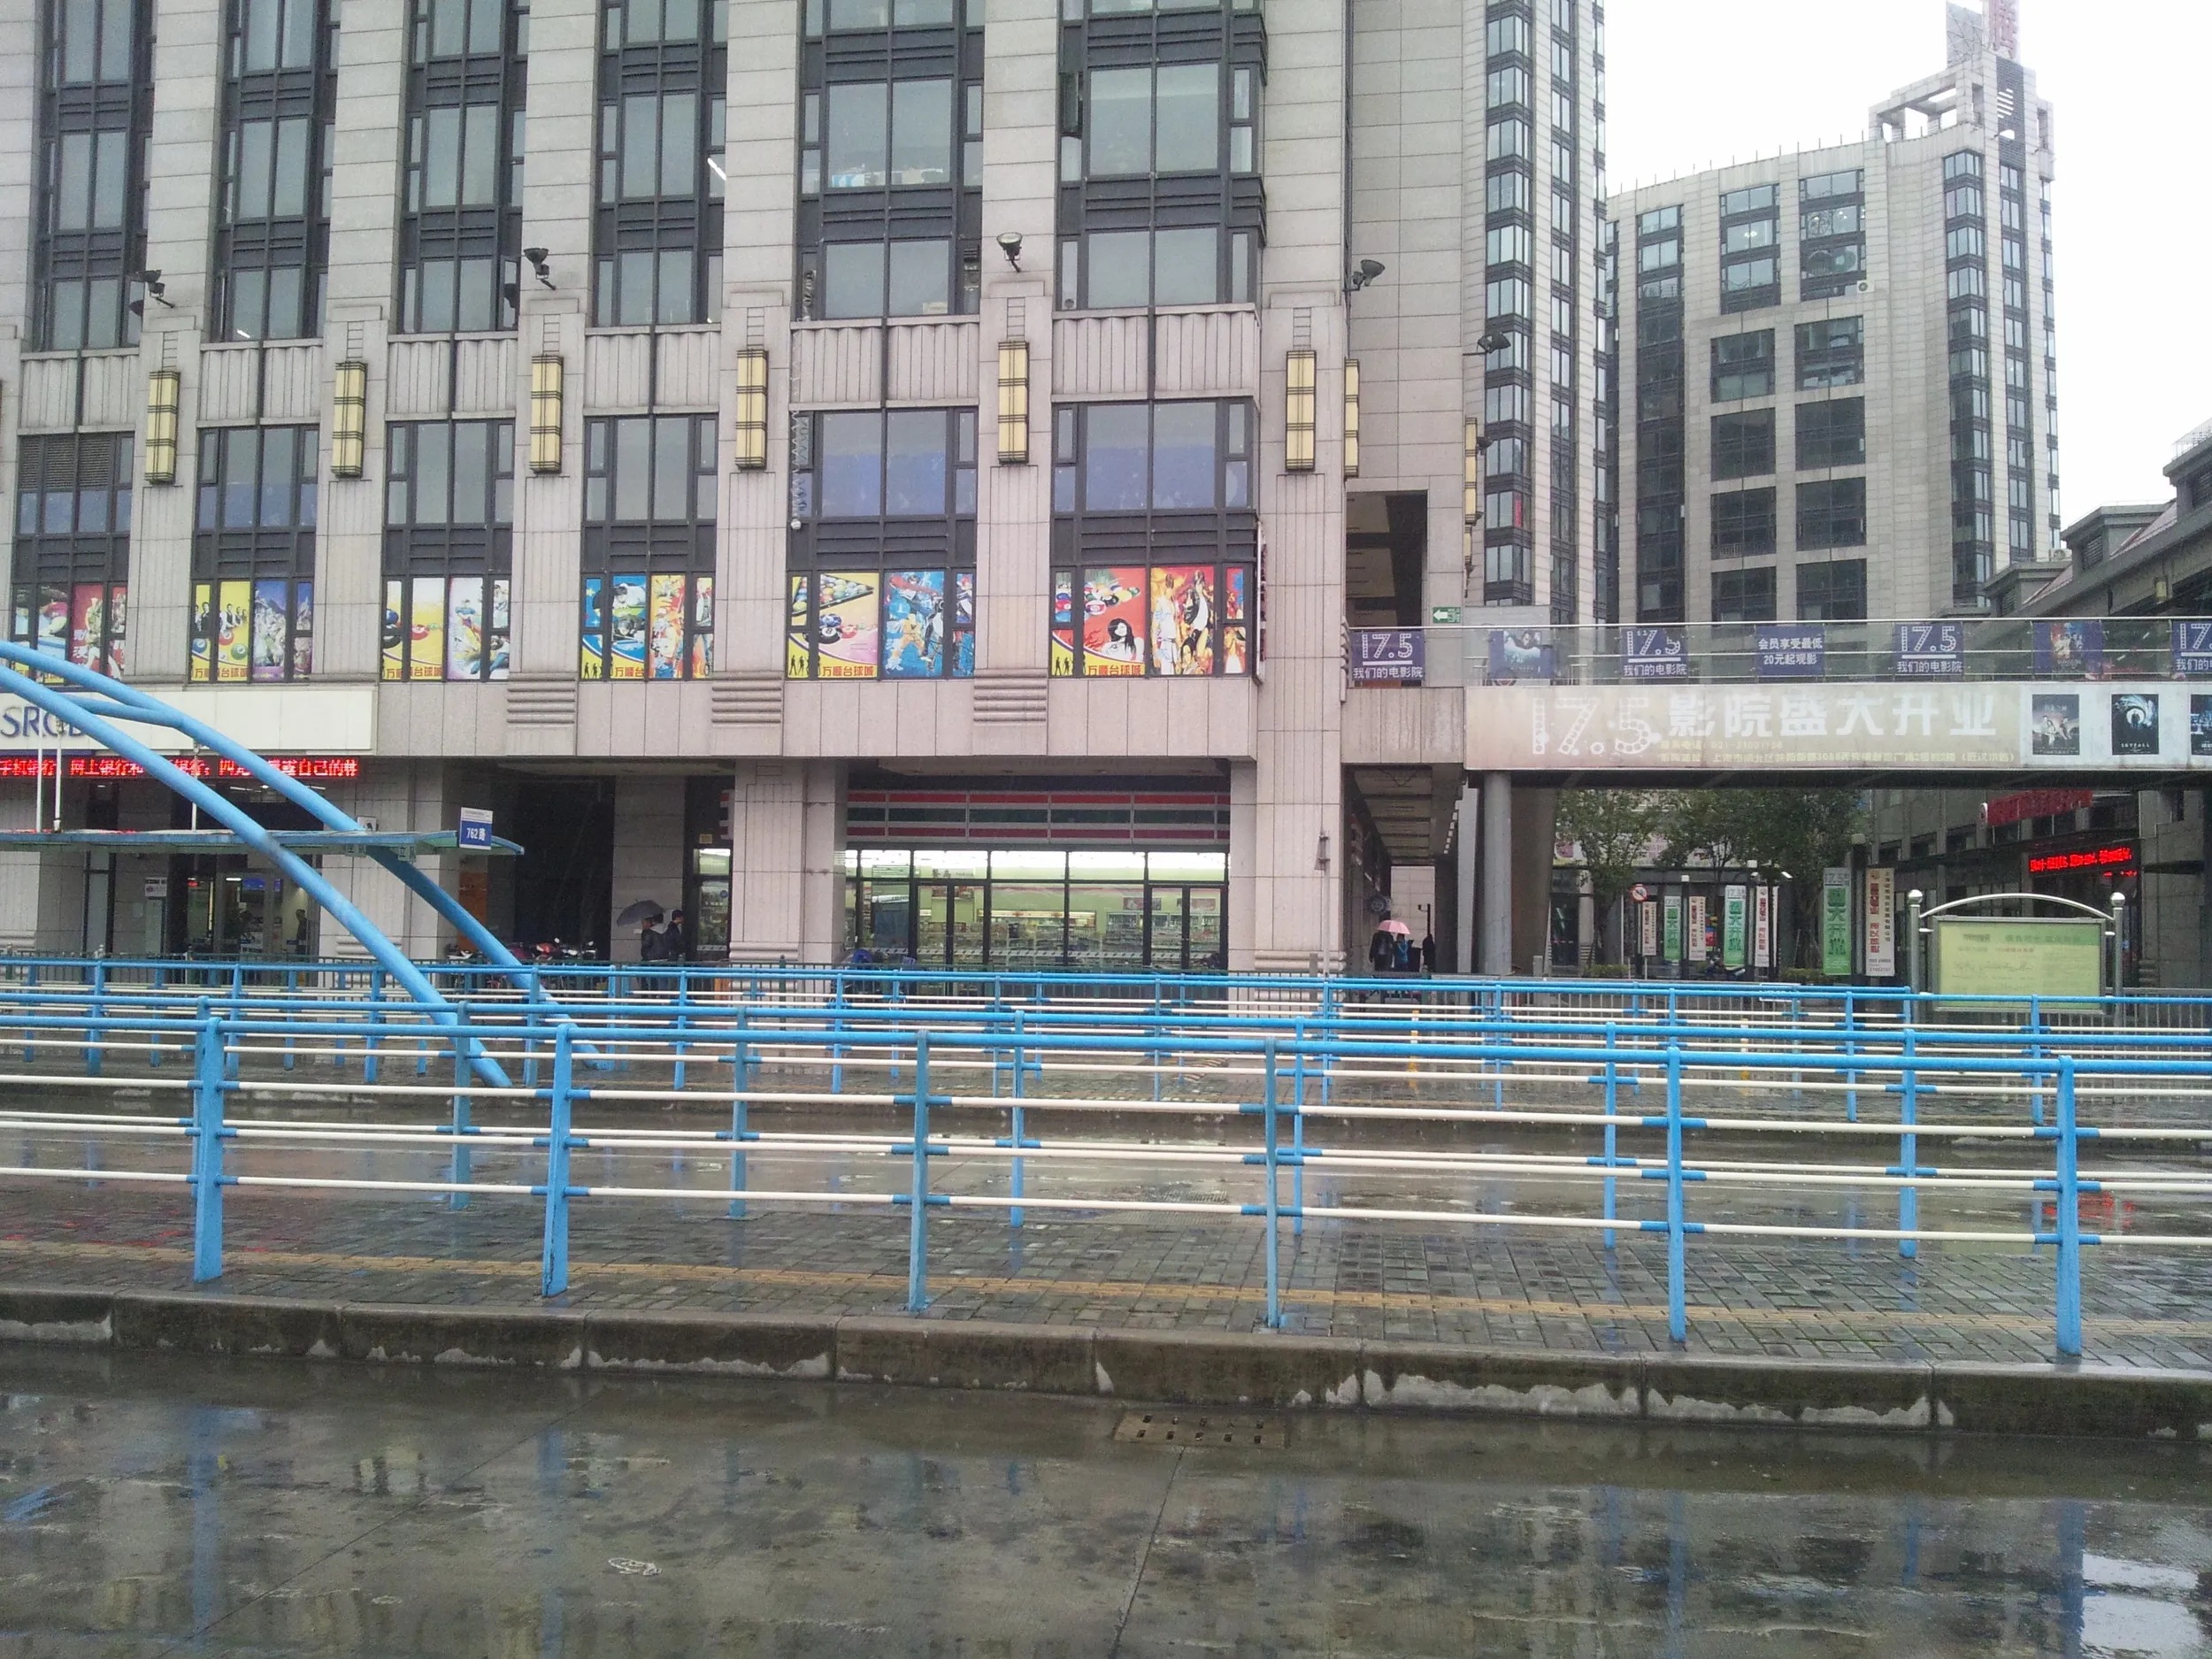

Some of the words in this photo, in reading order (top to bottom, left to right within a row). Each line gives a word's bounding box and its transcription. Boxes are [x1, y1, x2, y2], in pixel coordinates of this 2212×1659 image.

[1758, 637, 1823, 650] 会员享受最低
[1902, 626, 1956, 652] 17.5
[1362, 633, 1414, 659] 17.5
[1763, 654, 1817, 665] 20元起观影
[2176, 658, 2212, 671] 我们的
[1353, 666, 1424, 679] 我们的电影院
[1624, 664, 1687, 676] 我们的电影院
[1897, 661, 1962, 672] 我们的电影院
[1669, 692, 1997, 737] 影院盛大开业
